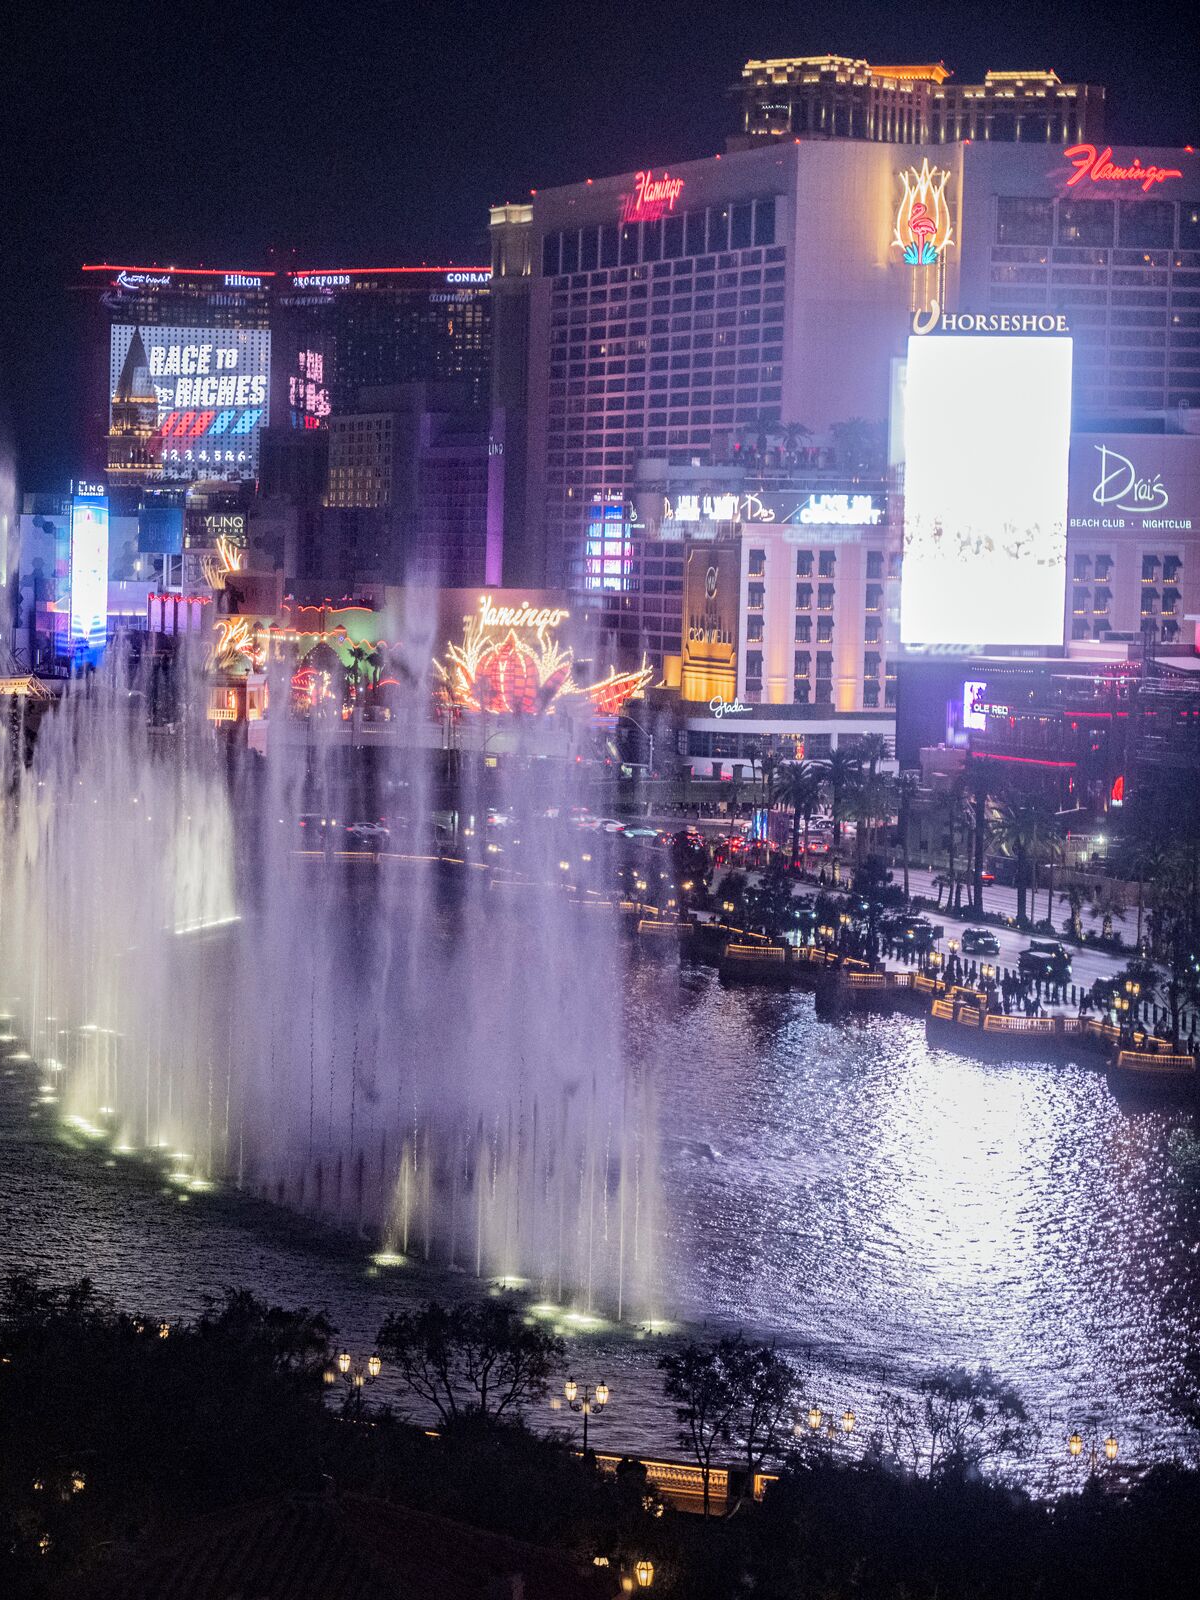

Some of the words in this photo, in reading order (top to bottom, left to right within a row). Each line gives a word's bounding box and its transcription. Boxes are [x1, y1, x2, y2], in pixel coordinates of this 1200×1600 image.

[1064, 144, 1182, 192] Flamingo
[635, 170, 685, 211] Flamingo
[224, 275, 261, 286] Hilton
[150, 344, 213, 376] RACE
[216, 349, 238, 369] TO
[175, 375, 267, 407] RICHES
[1070, 519, 1099, 528] BEACH
[1102, 519, 1125, 528] CLUB
[1142, 520, 1192, 529] NIGHTCLUB
[709, 696, 753, 718] Giada
[973, 703, 989, 712] OLE
[992, 705, 1008, 715] RED
